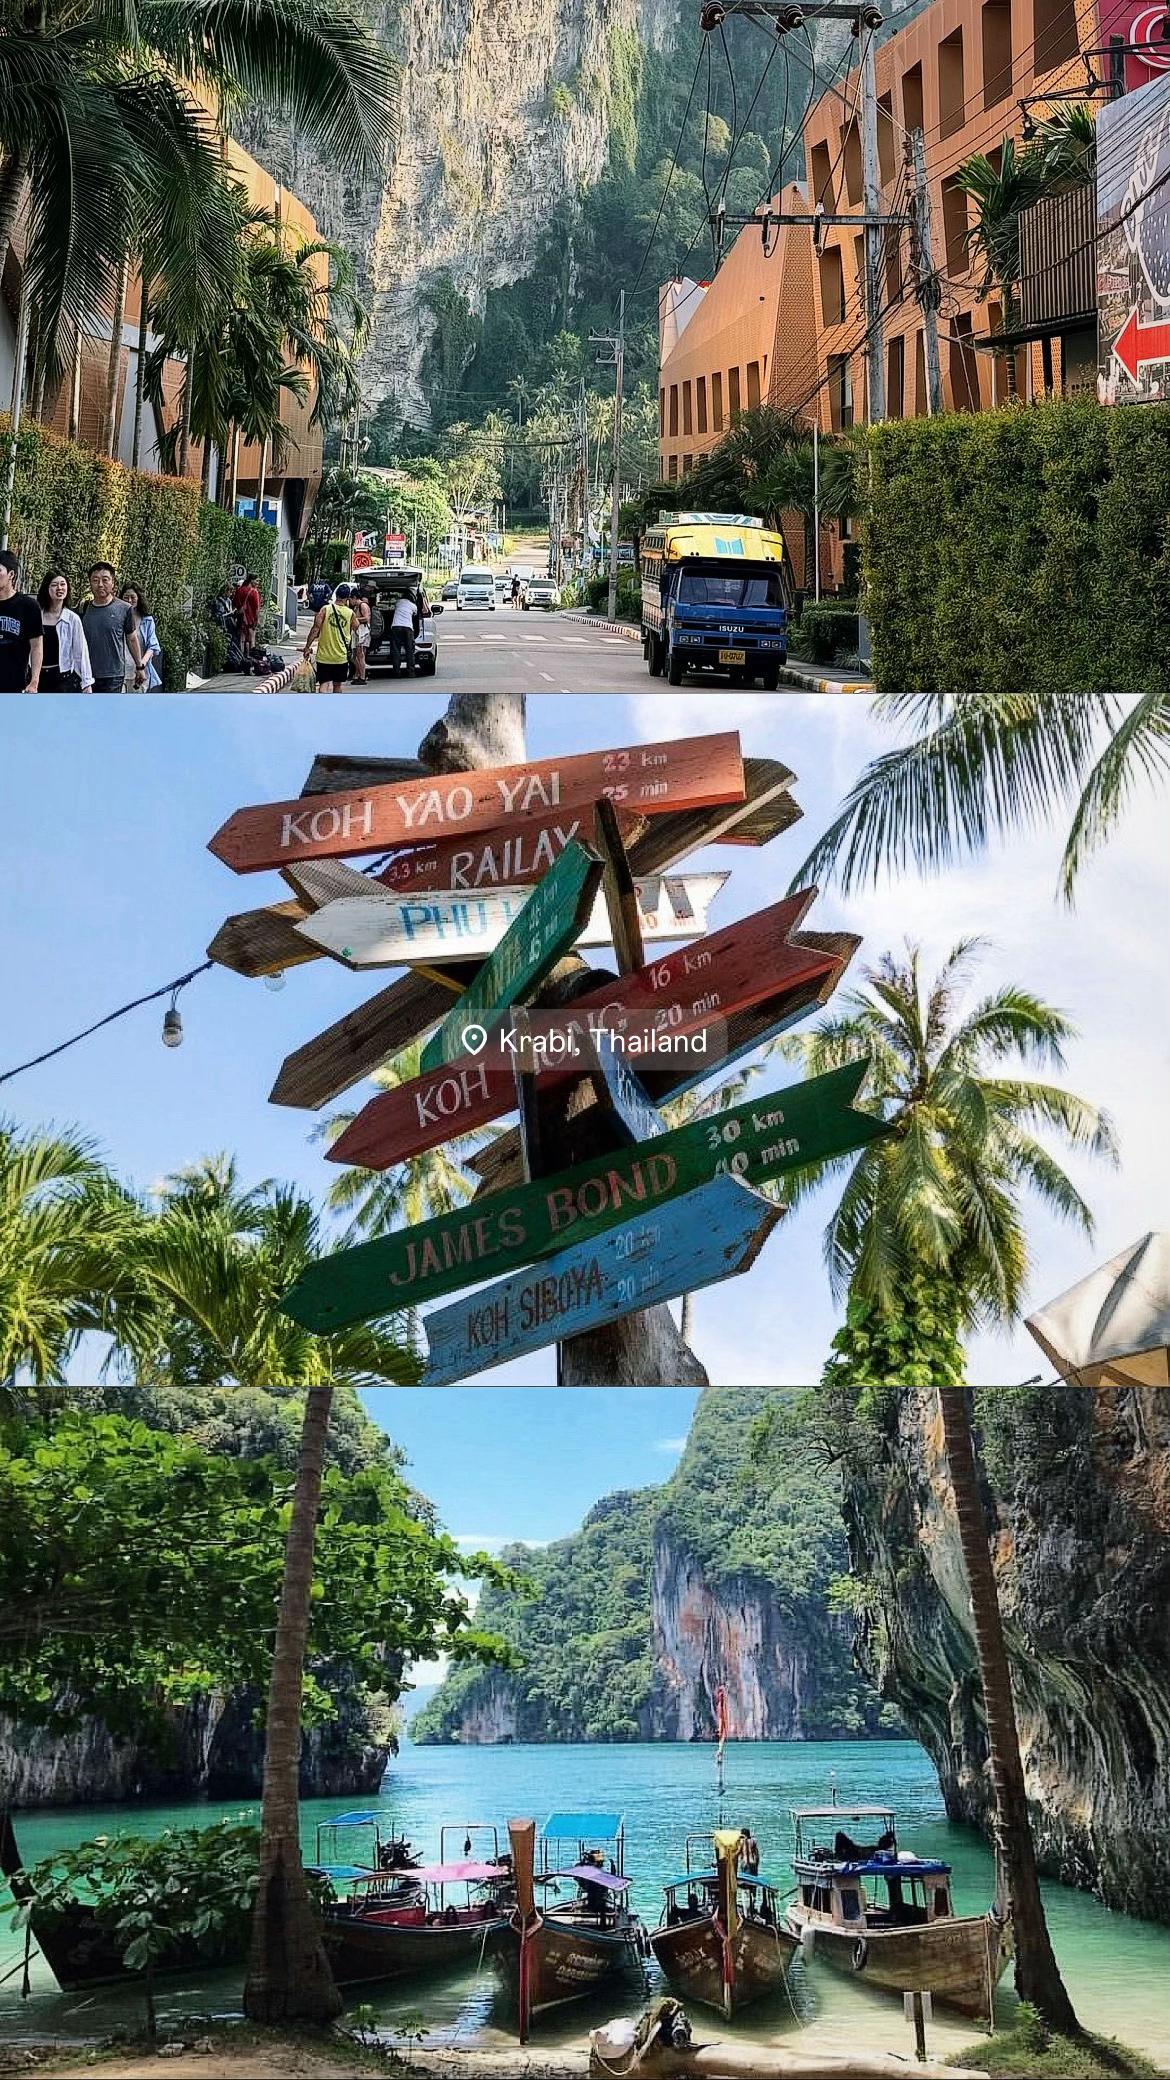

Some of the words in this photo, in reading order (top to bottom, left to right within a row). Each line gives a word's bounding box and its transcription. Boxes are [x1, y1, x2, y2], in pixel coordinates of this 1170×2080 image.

[719, 625, 745, 633] ISUZU
[603, 752, 630, 773] 23
[641, 752, 668, 768] km
[280, 801, 373, 847] KOH
[396, 786, 473, 828] YAO
[496, 771, 560, 813] YAI
[641, 780, 668, 799] min
[451, 821, 580, 889] RAILAY
[649, 963, 671, 992] 16
[683, 951, 712, 975] km
[655, 1002, 683, 1032] 20
[692, 992, 720, 1016] min
[414, 1062, 491, 1128] KOH
[705, 1120, 741, 1151] 30
[752, 1110, 785, 1133] km
[761, 1138, 800, 1166] min
[390, 1208, 527, 1286] JAMES
[546, 1154, 678, 1232] BOND
[468, 1297, 509, 1349] KOH
[520, 1257, 604, 1331] SIBOYA
